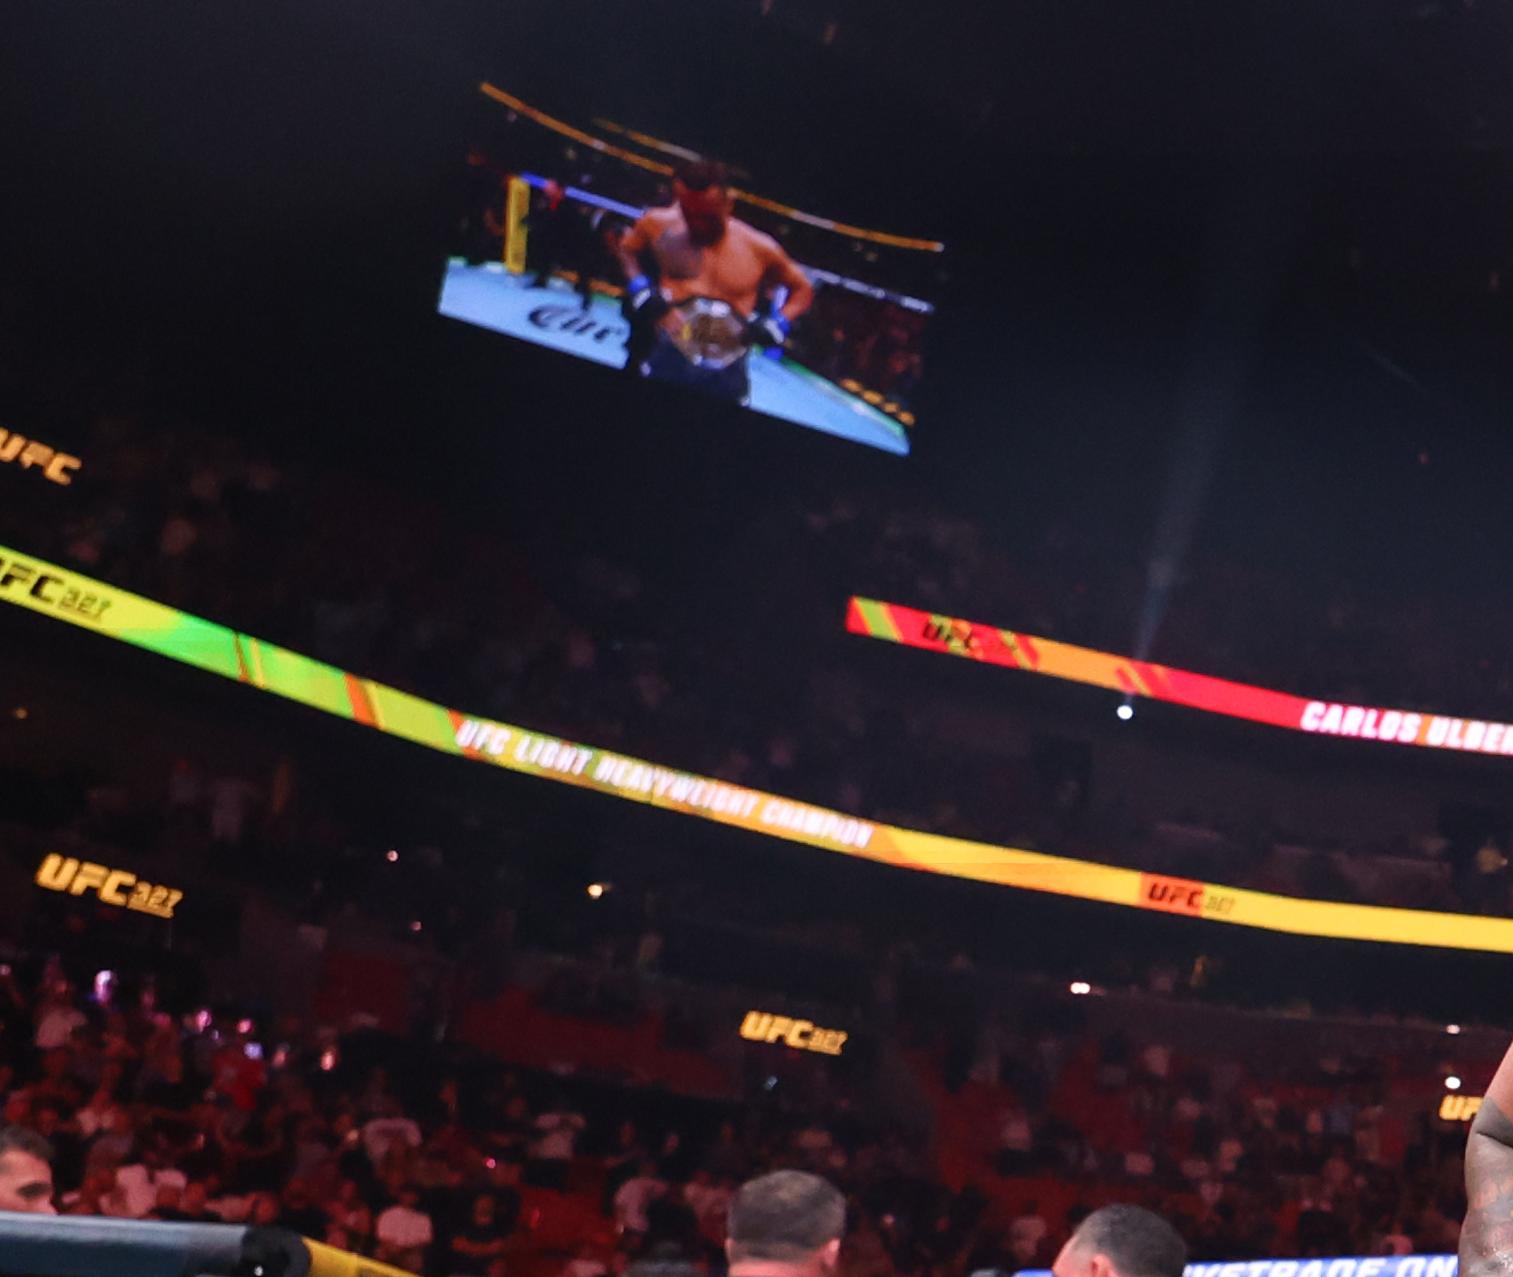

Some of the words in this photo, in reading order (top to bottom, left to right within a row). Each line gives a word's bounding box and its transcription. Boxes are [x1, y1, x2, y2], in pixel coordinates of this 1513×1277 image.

[0, 558, 64, 604] FC
[1301, 701, 1421, 743] CARLOS
[456, 718, 513, 755] UFC
[514, 732, 593, 775] LIGHT
[594, 760, 760, 818] HEAVYWEIGHT
[761, 798, 874, 849] CHAMPION
[36, 853, 136, 907] UFC
[1148, 882, 1203, 909] UFC
[739, 1009, 815, 1050] UFC
